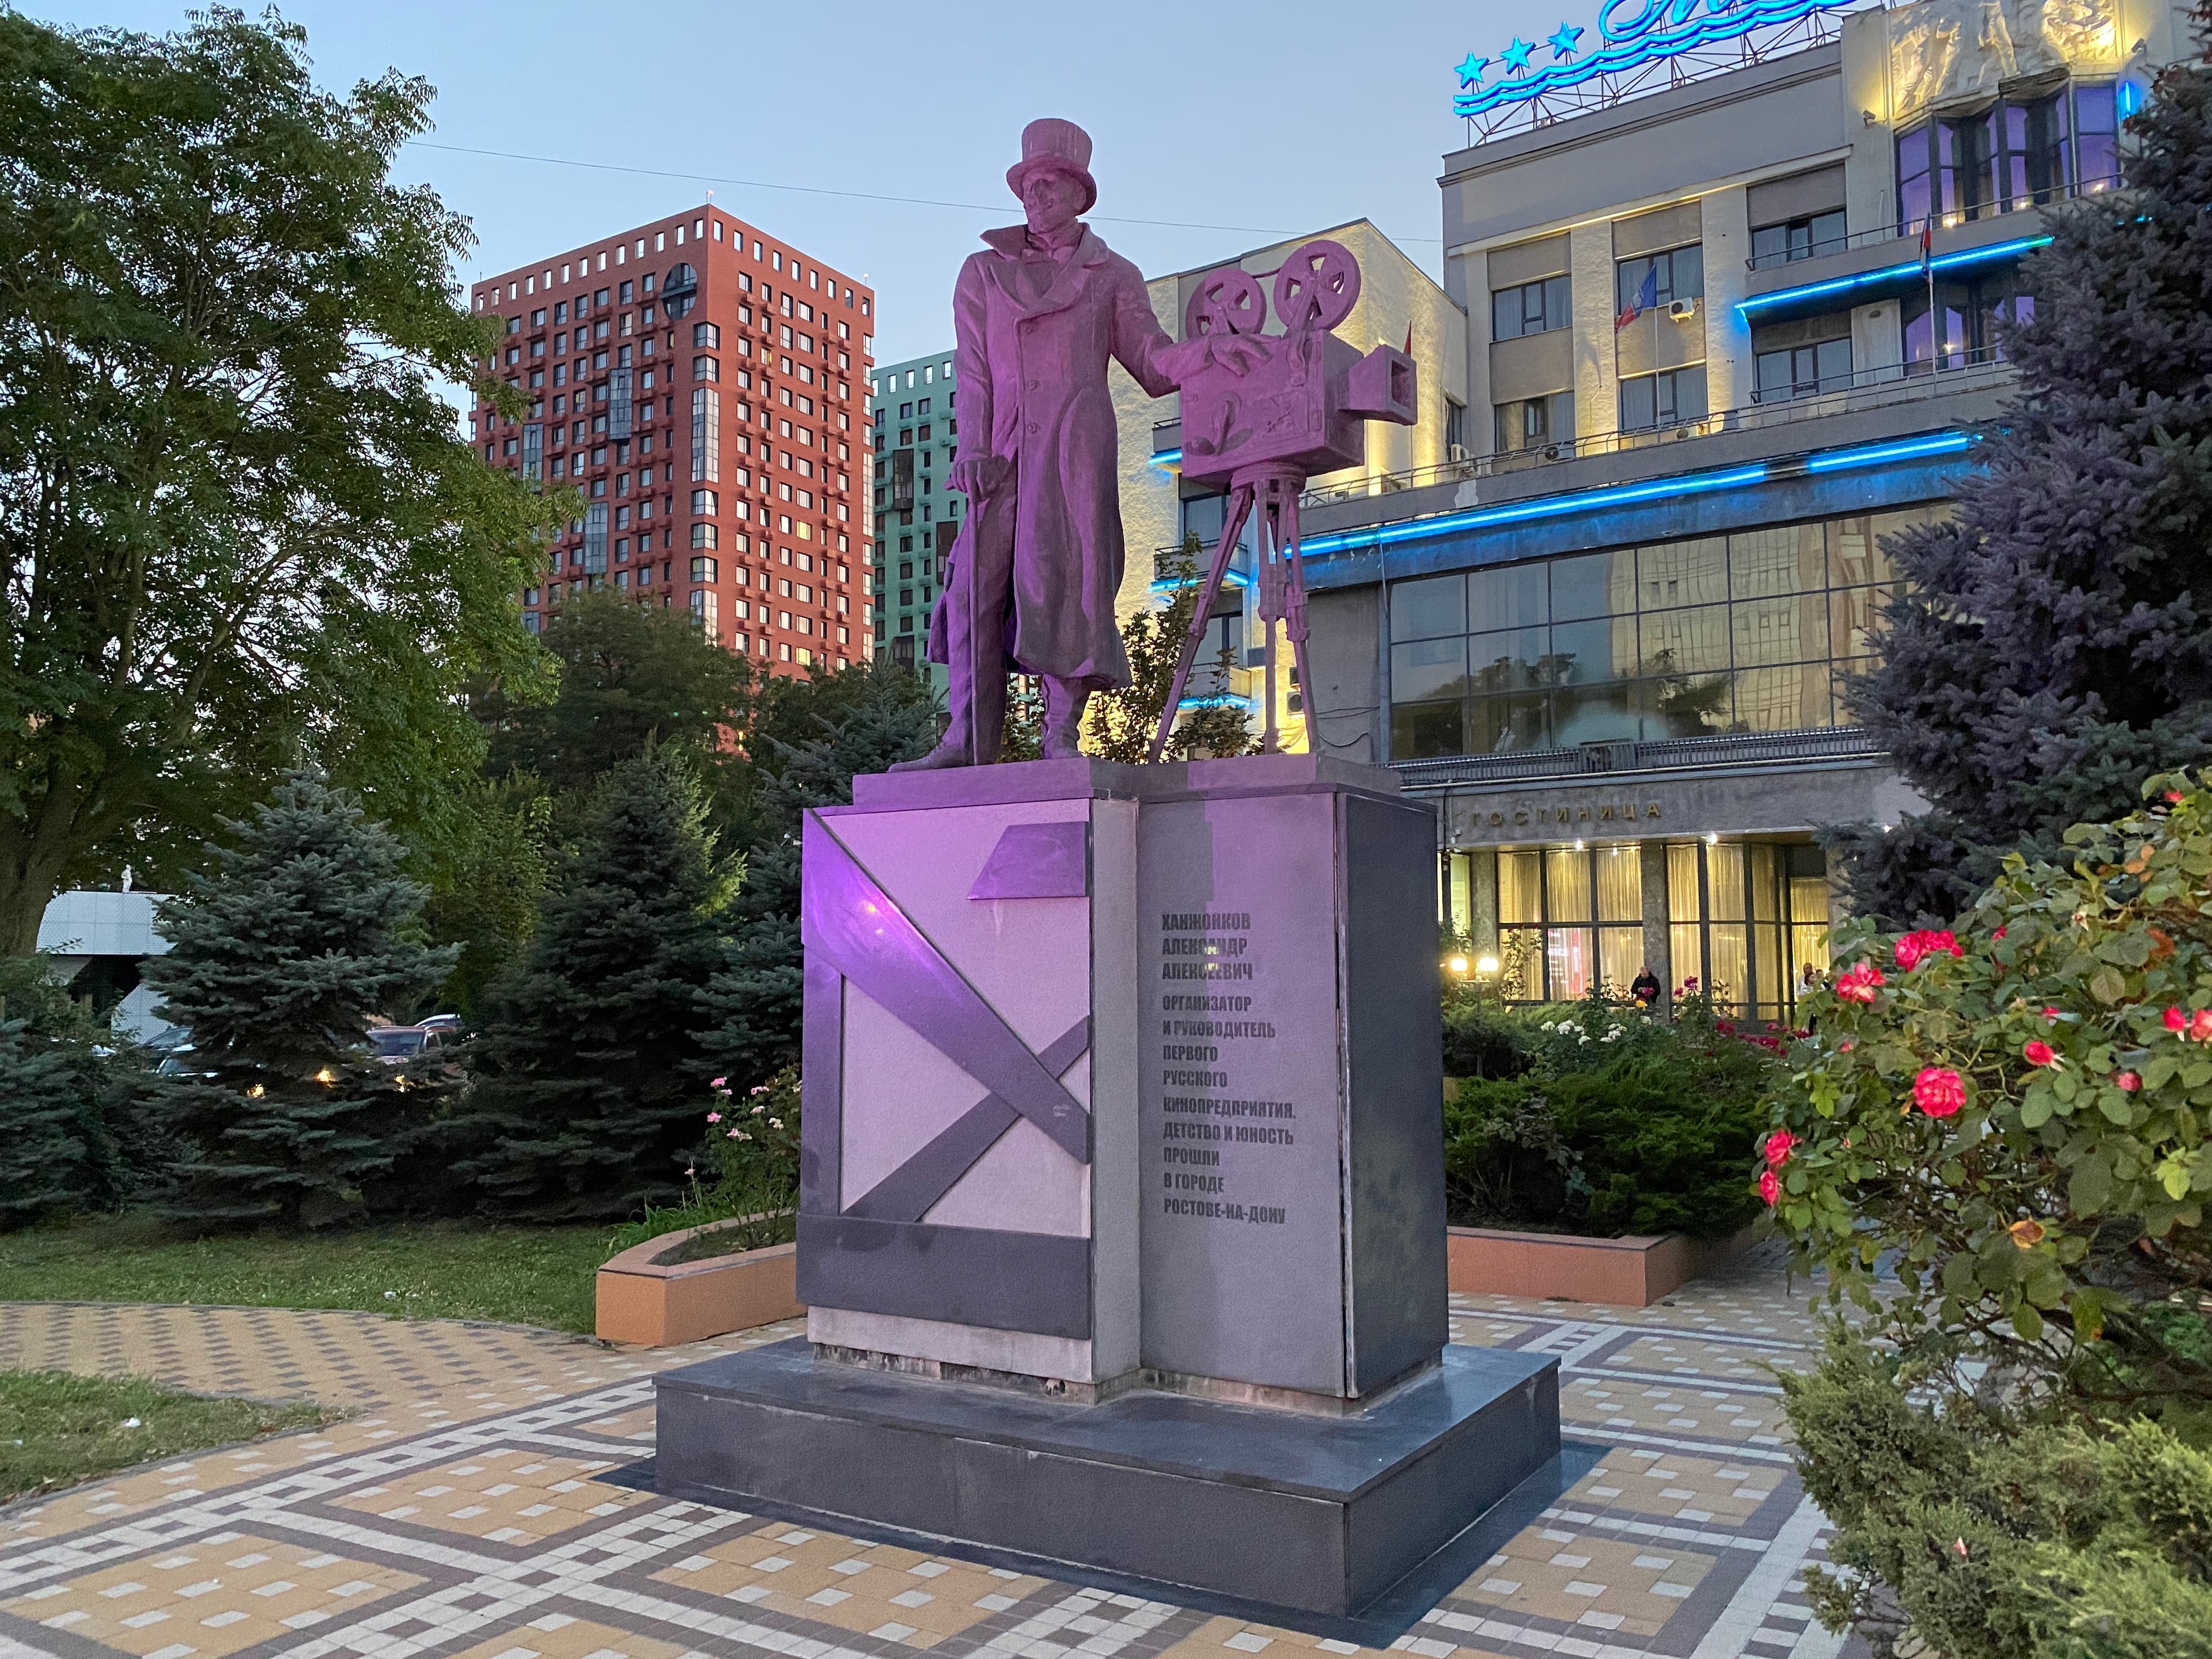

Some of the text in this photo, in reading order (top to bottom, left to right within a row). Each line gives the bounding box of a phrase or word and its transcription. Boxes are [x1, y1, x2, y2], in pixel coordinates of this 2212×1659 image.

[1472, 802, 1661, 826] ГОСТИНИЦА
[1162, 913, 1251, 930] ХАНЖОНКОВ
[1162, 938, 1247, 957] АЛЕКСАНДР
[1162, 963, 1252, 980] АЛЕКСЕЕВИЧ
[1162, 995, 1251, 1012] ОРГАНИЗАТОР
[1163, 1021, 1275, 1039] И РУКОВОДИТЕЛЬ
[1163, 1046, 1218, 1061] ПЕРВОГО
[1163, 1070, 1227, 1087] РУССКОГО
[1164, 1097, 1296, 1119] КИНОПРЕДПРИЯТИЯ.
[1163, 1122, 1294, 1145] ДЕТСТВО И ЮНОСТЬ
[1164, 1147, 1219, 1166] ПРОШЛИ
[1164, 1173, 1224, 1194] В ГОРОДЕ
[1164, 1199, 1286, 1224] РОСТОВЕ-НА-ДОНУ
